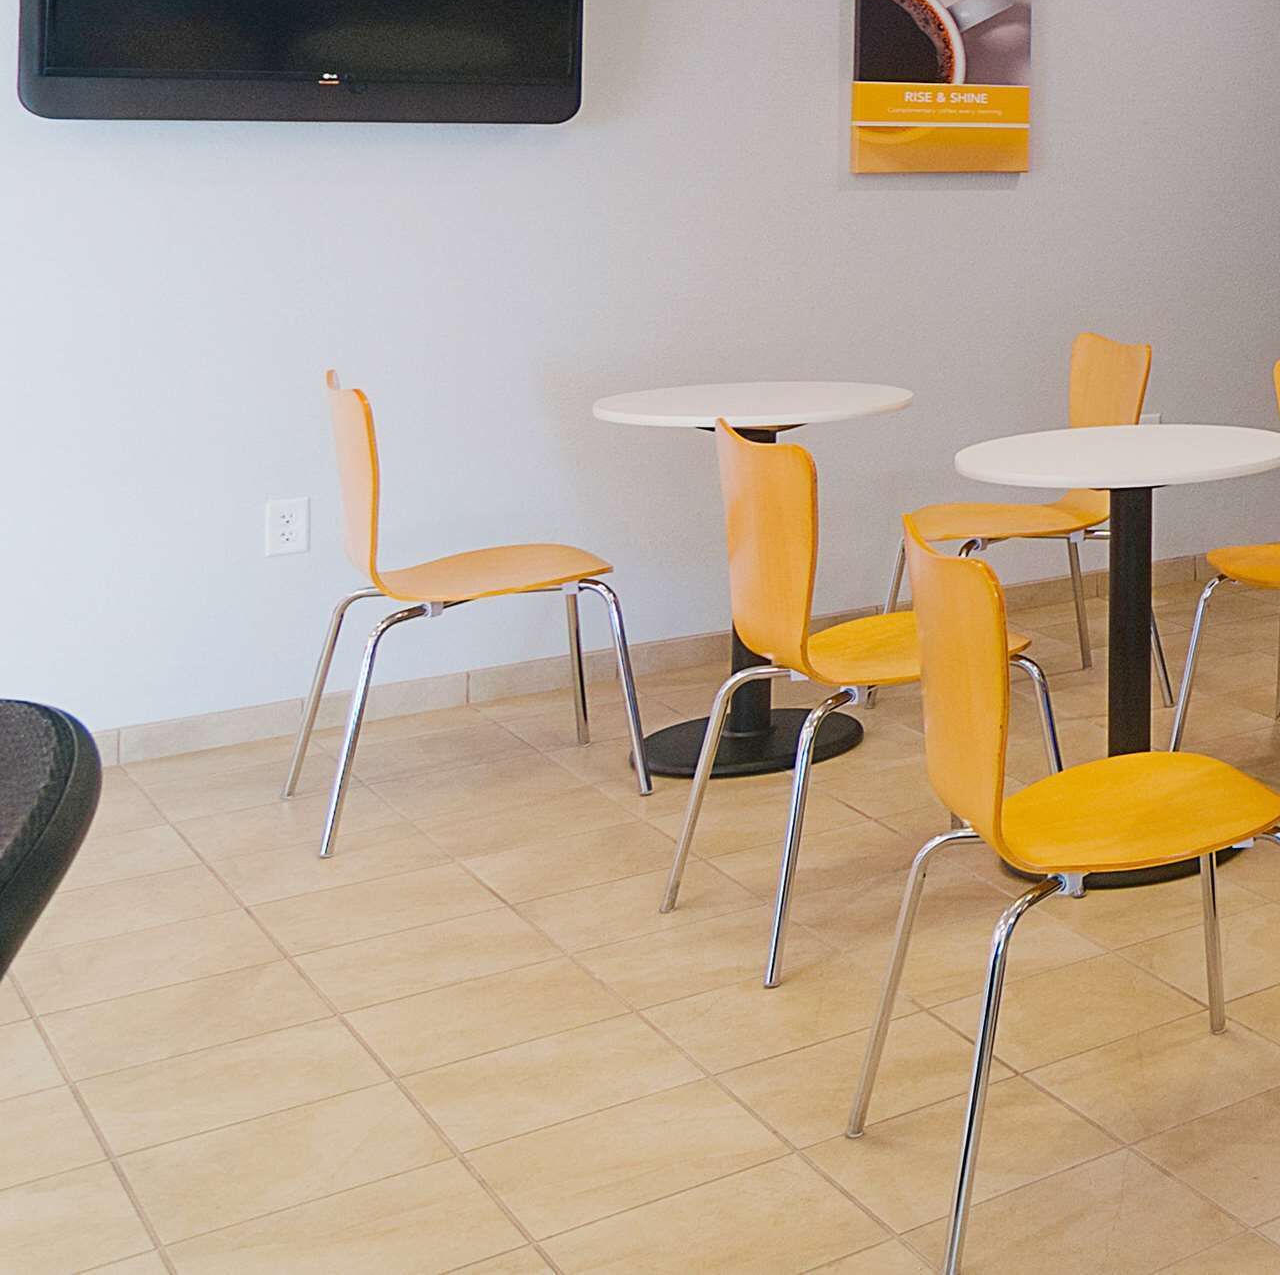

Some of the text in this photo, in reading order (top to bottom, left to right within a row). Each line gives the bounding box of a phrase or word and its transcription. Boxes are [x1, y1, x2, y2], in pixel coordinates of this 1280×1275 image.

[904, 91, 989, 104] RISE & SHINE
